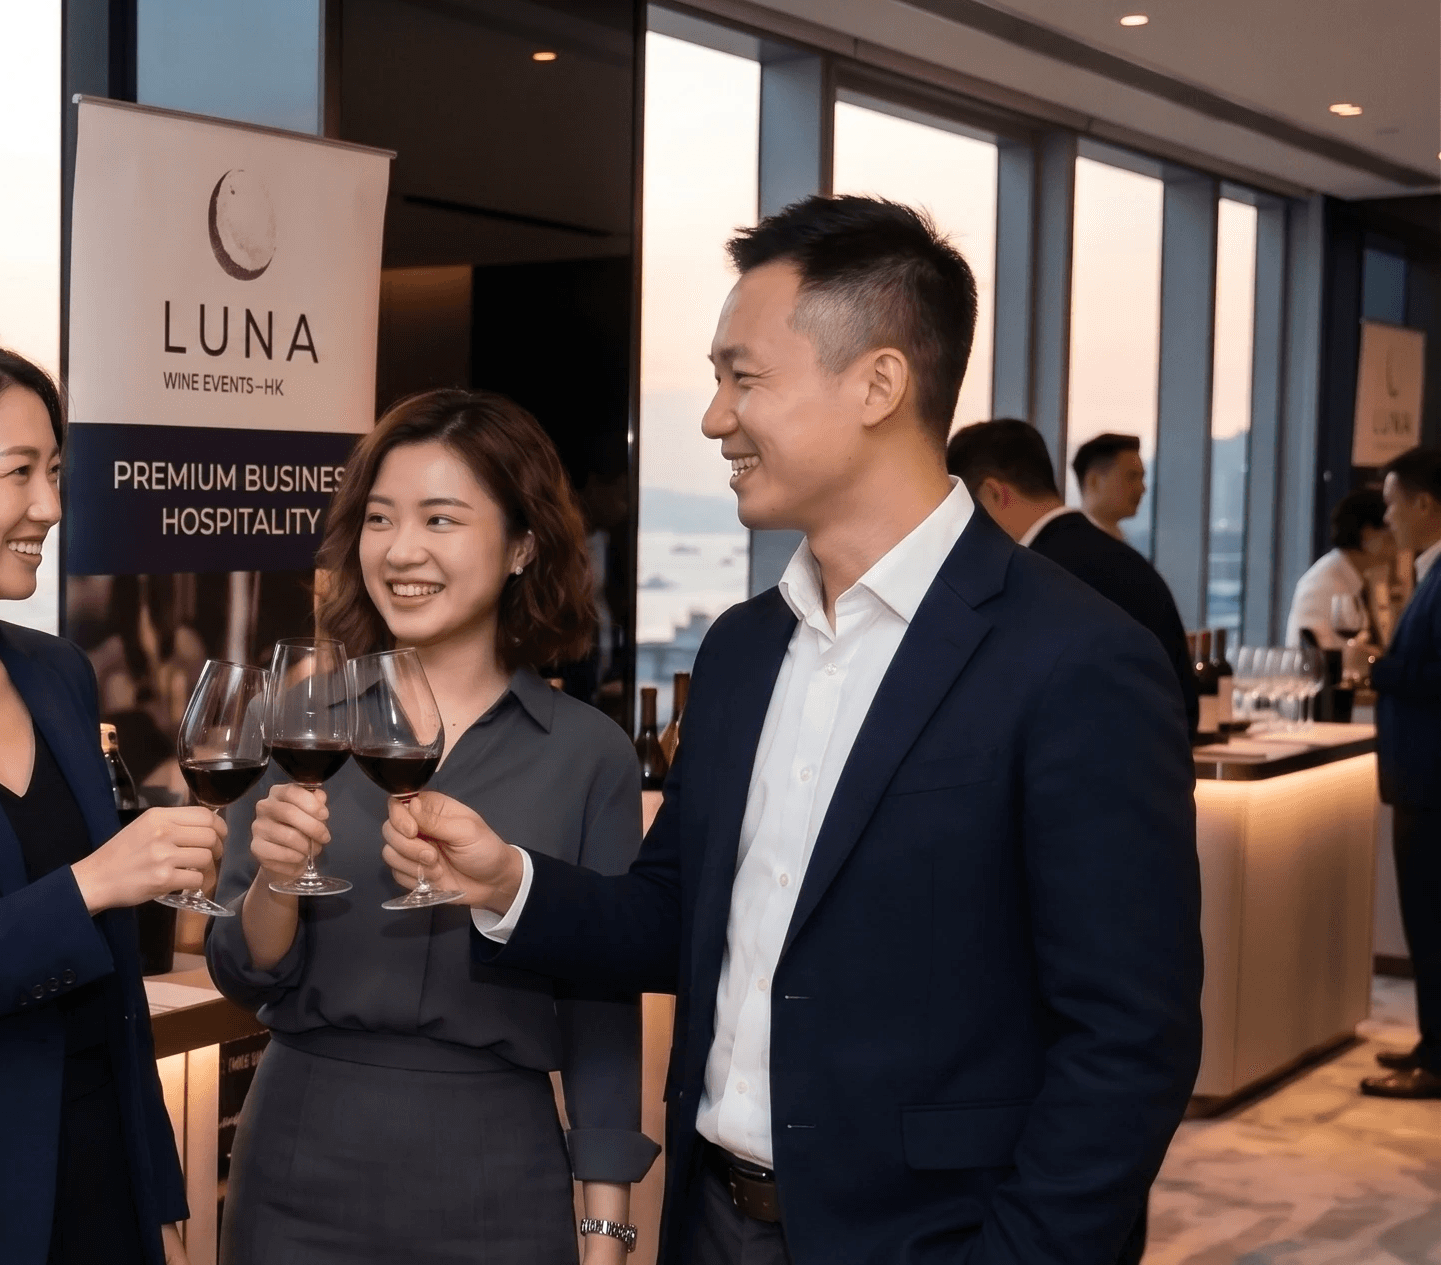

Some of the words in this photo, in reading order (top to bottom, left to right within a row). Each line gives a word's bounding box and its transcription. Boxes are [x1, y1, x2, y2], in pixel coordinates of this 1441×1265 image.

[164, 300, 319, 363] LUNA
[163, 371, 199, 392] WINE
[113, 461, 236, 491] PREMIUM
[245, 465, 345, 493] BUSINES
[162, 508, 321, 535] HOSPITALITY
